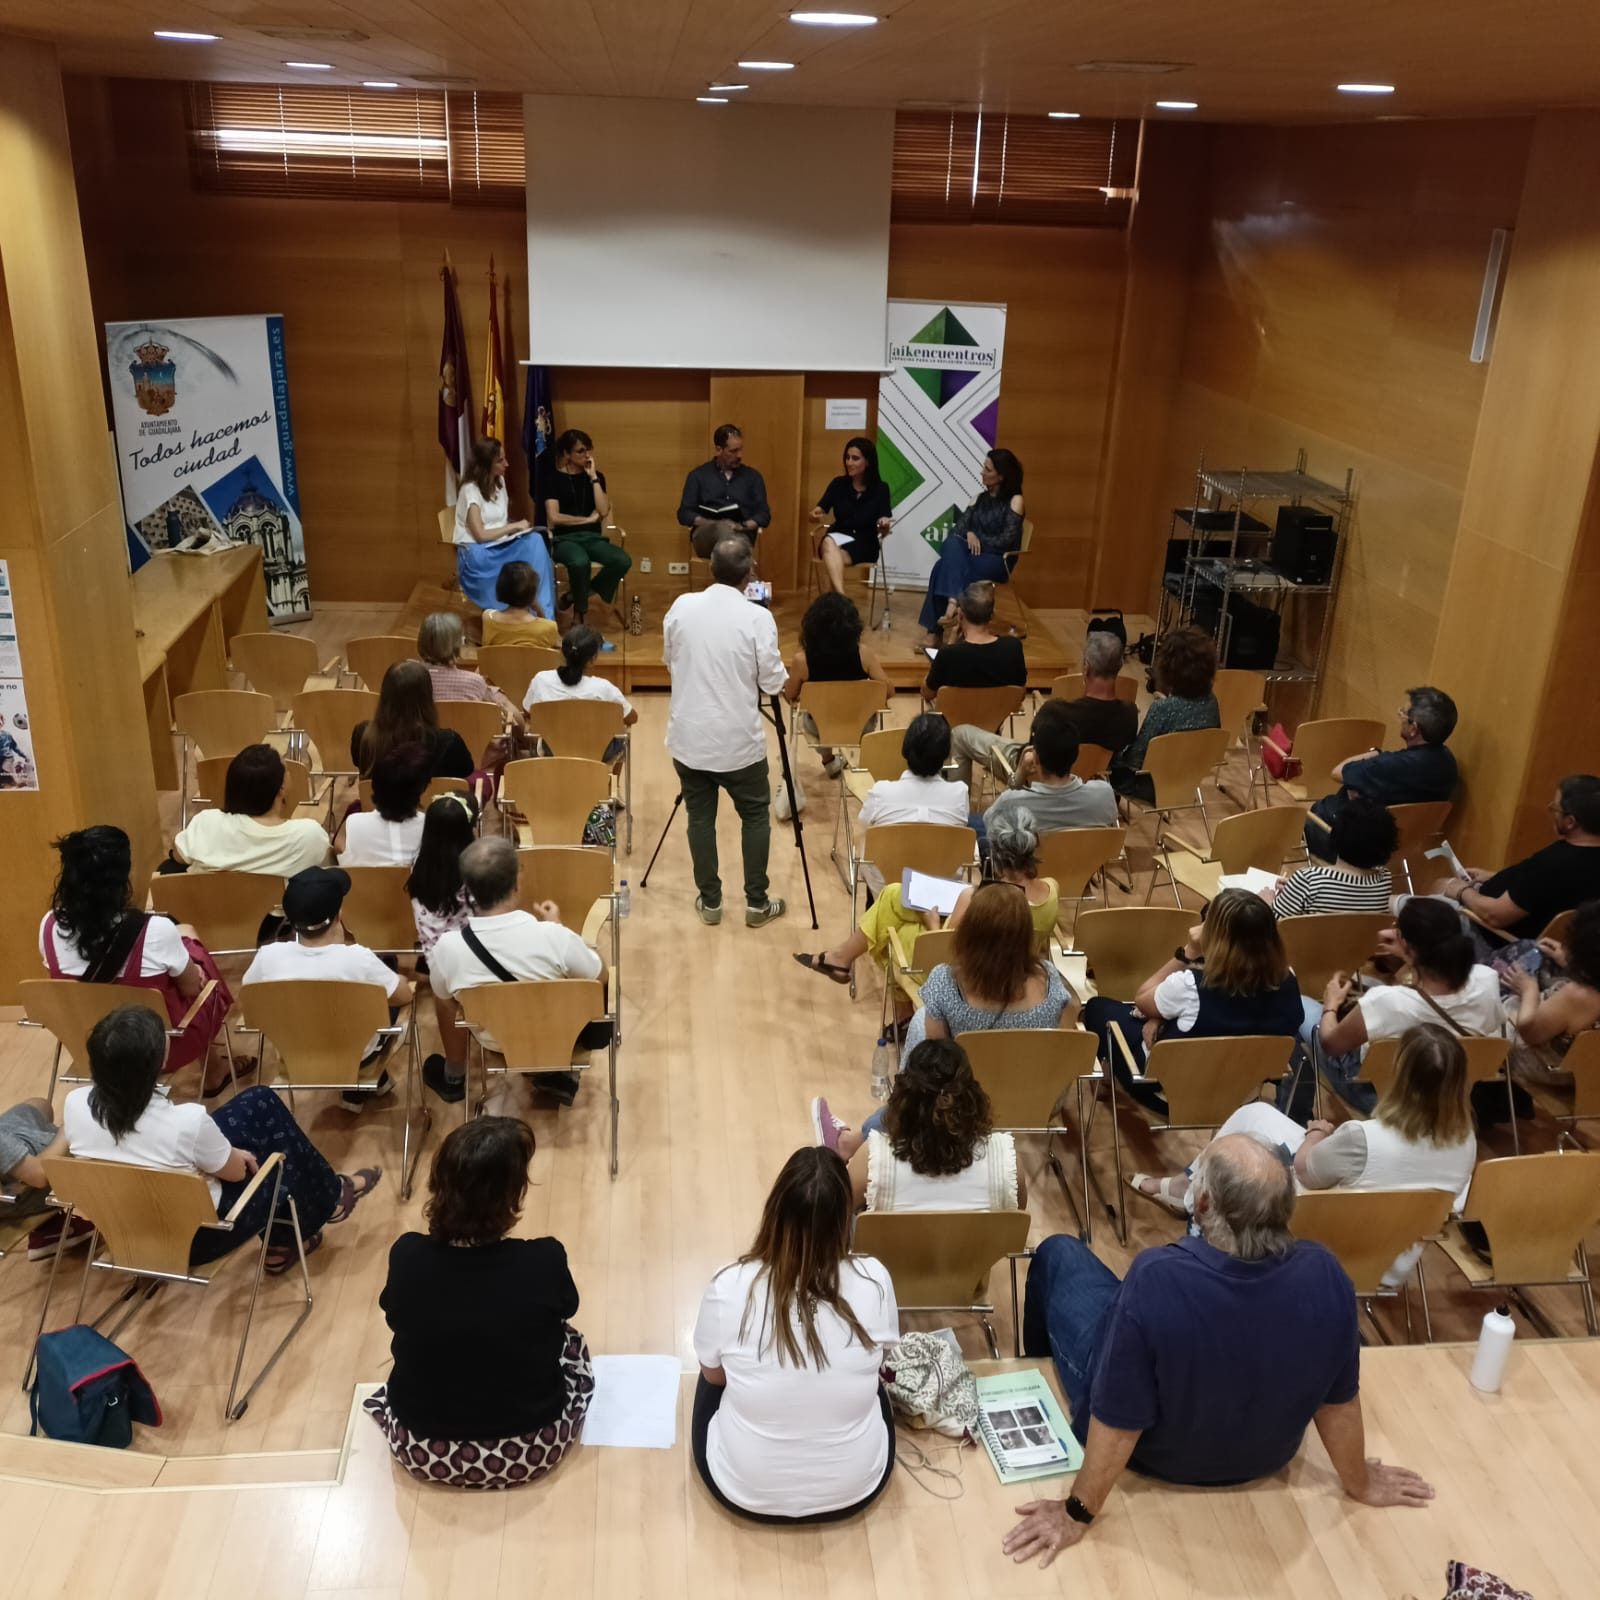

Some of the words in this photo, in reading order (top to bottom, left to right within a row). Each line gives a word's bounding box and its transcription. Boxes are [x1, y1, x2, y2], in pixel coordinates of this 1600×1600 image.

[129, 442, 186, 470] Todos
[190, 410, 272, 449] hacemos
[272, 327, 295, 496] www.guadalajara.es
[173, 437, 242, 478] ciudad
